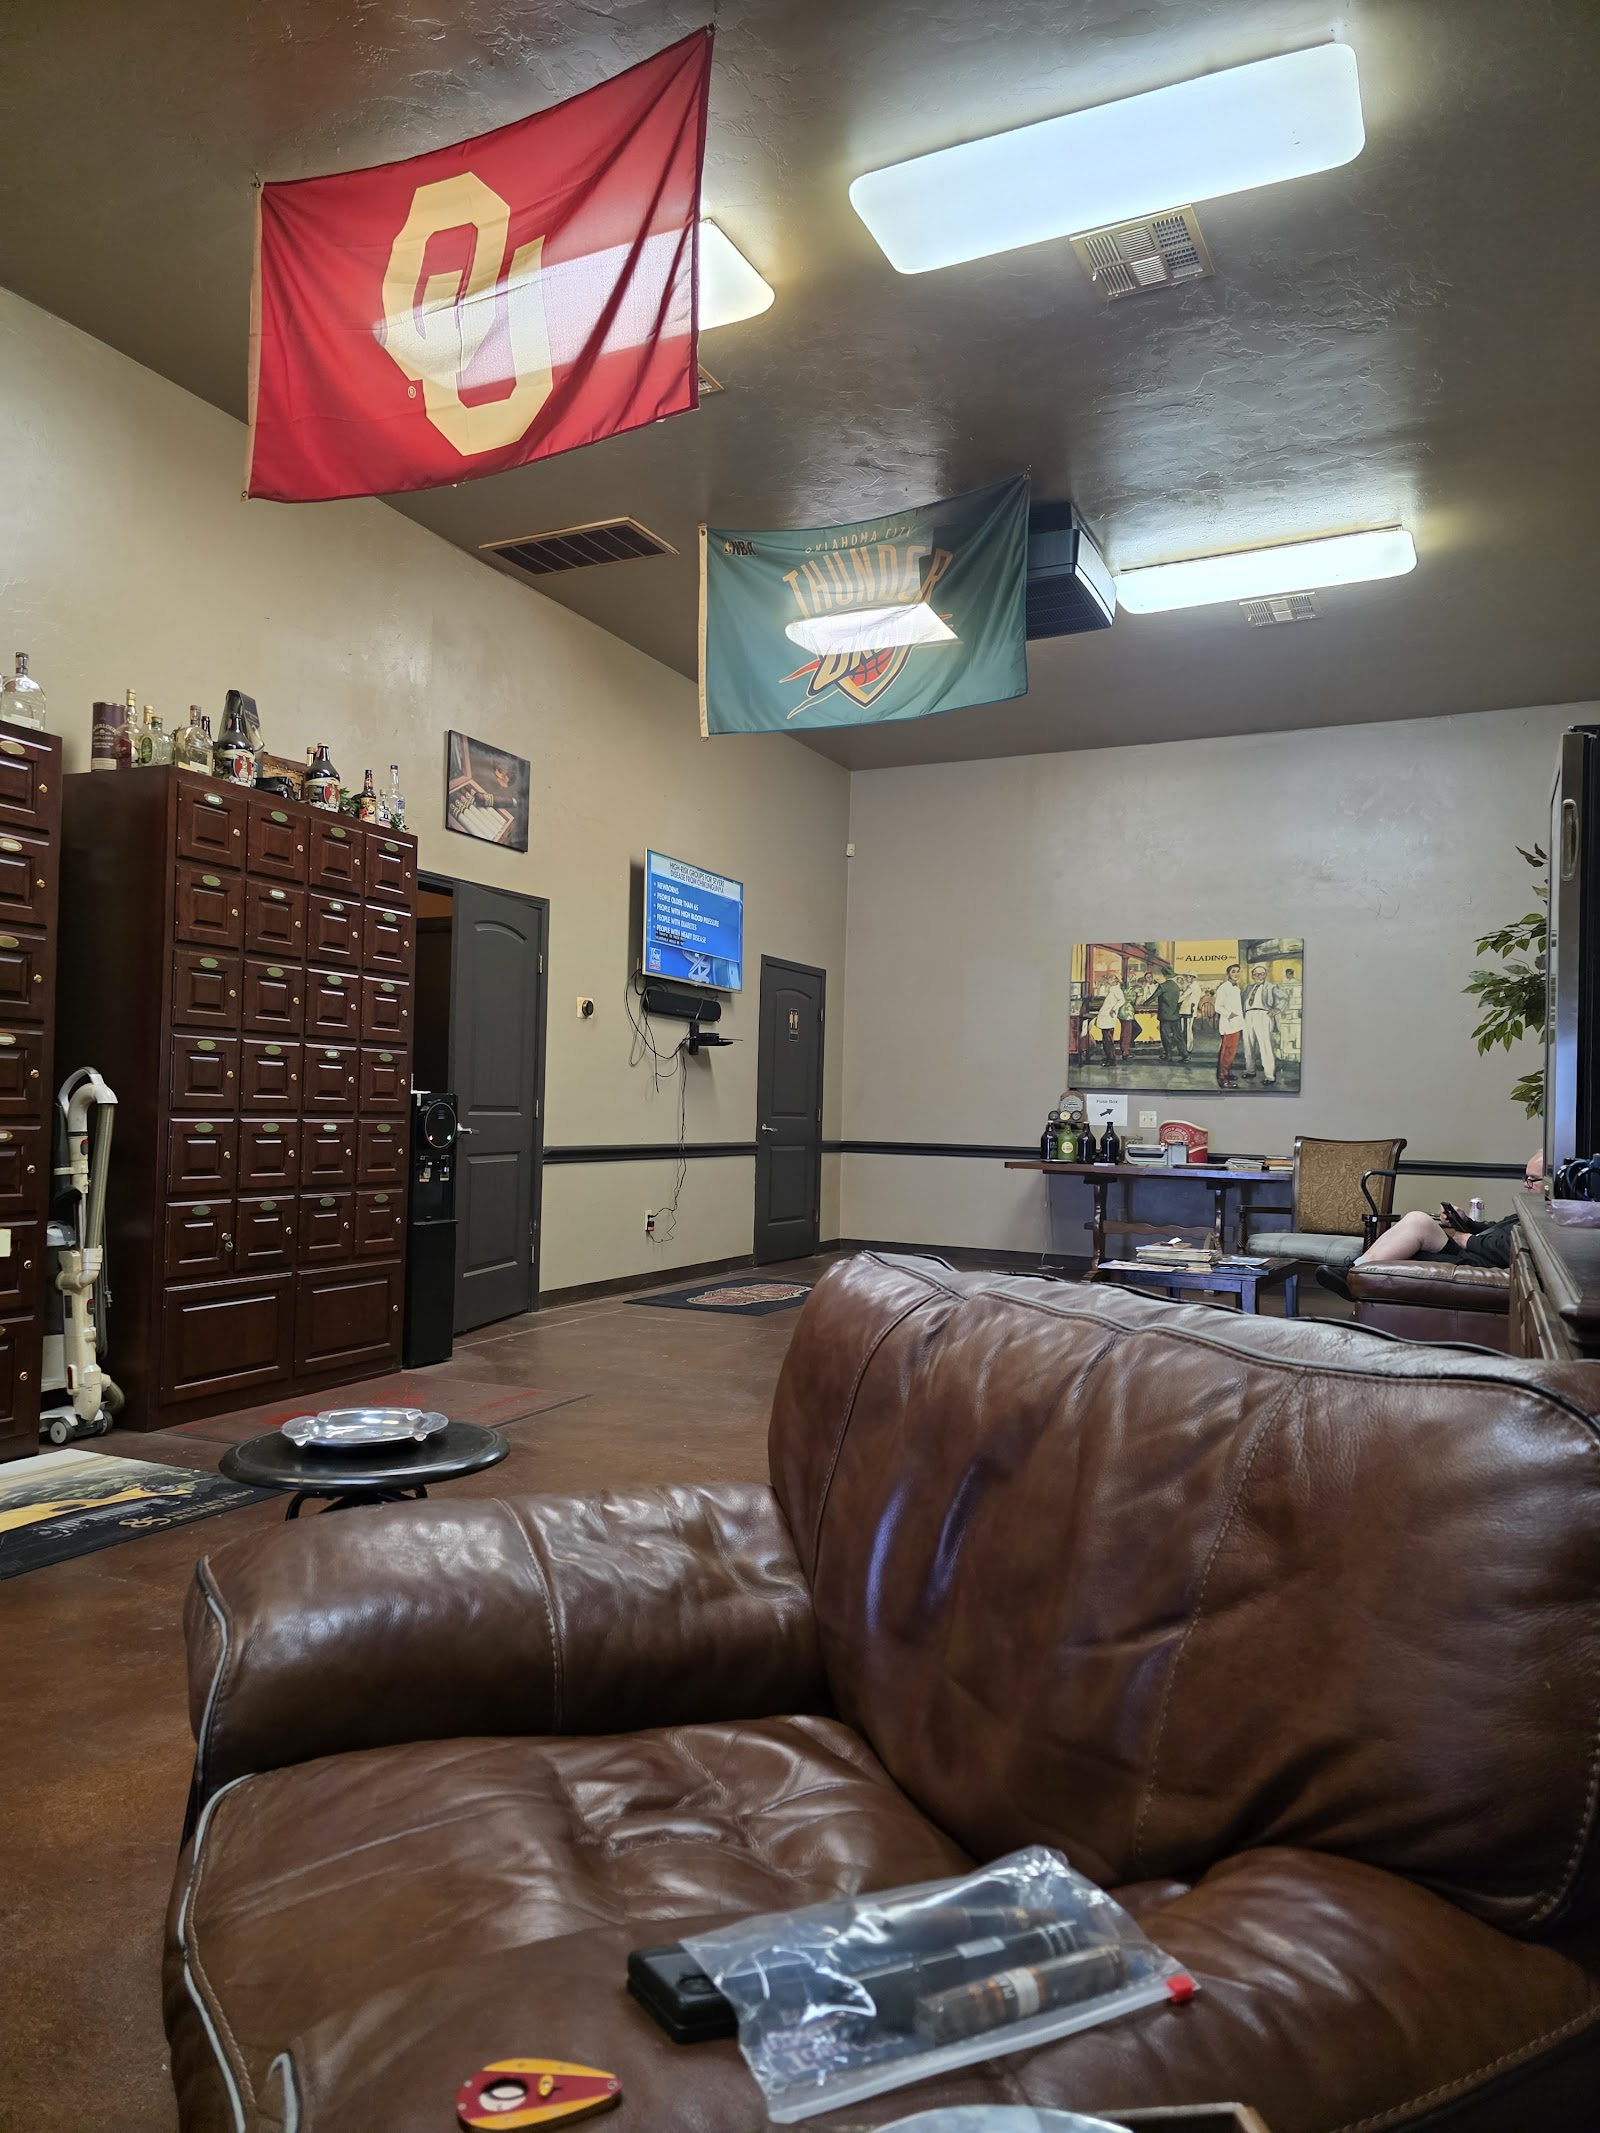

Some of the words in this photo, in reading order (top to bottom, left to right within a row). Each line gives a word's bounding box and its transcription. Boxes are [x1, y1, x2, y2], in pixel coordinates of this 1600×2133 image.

[381, 171, 554, 457] OU
[732, 540, 757, 556] NBA
[782, 544, 953, 620] THUNDER
[670, 869, 686, 883] DISEASE
[685, 874, 697, 885] FROM
[688, 868, 705, 881] GROUPS
[712, 876, 725, 888] SEVERE
[656, 881, 680, 895] NEWBORNS
[656, 892, 671, 903] PEOPLE
[670, 896, 683, 907] OLDER
[682, 900, 694, 910] THAN
[656, 902, 671, 913] PEOPLE
[670, 906, 681, 916] WITH
[680, 910, 691, 919] HIGH
[690, 912, 704, 923] BLOOD
[703, 916, 720, 928] PRESSURE
[656, 913, 671, 924] PEOPLE
[670, 917, 681, 927] WITH
[680, 920, 697, 931] DIABETES
[656, 924, 671, 934] PEOPLE
[670, 927, 681, 936] WITH
[680, 930, 693, 940] HEART
[692, 933, 707, 944] DISEASE
[1185, 954, 1228, 962] ALADINO
